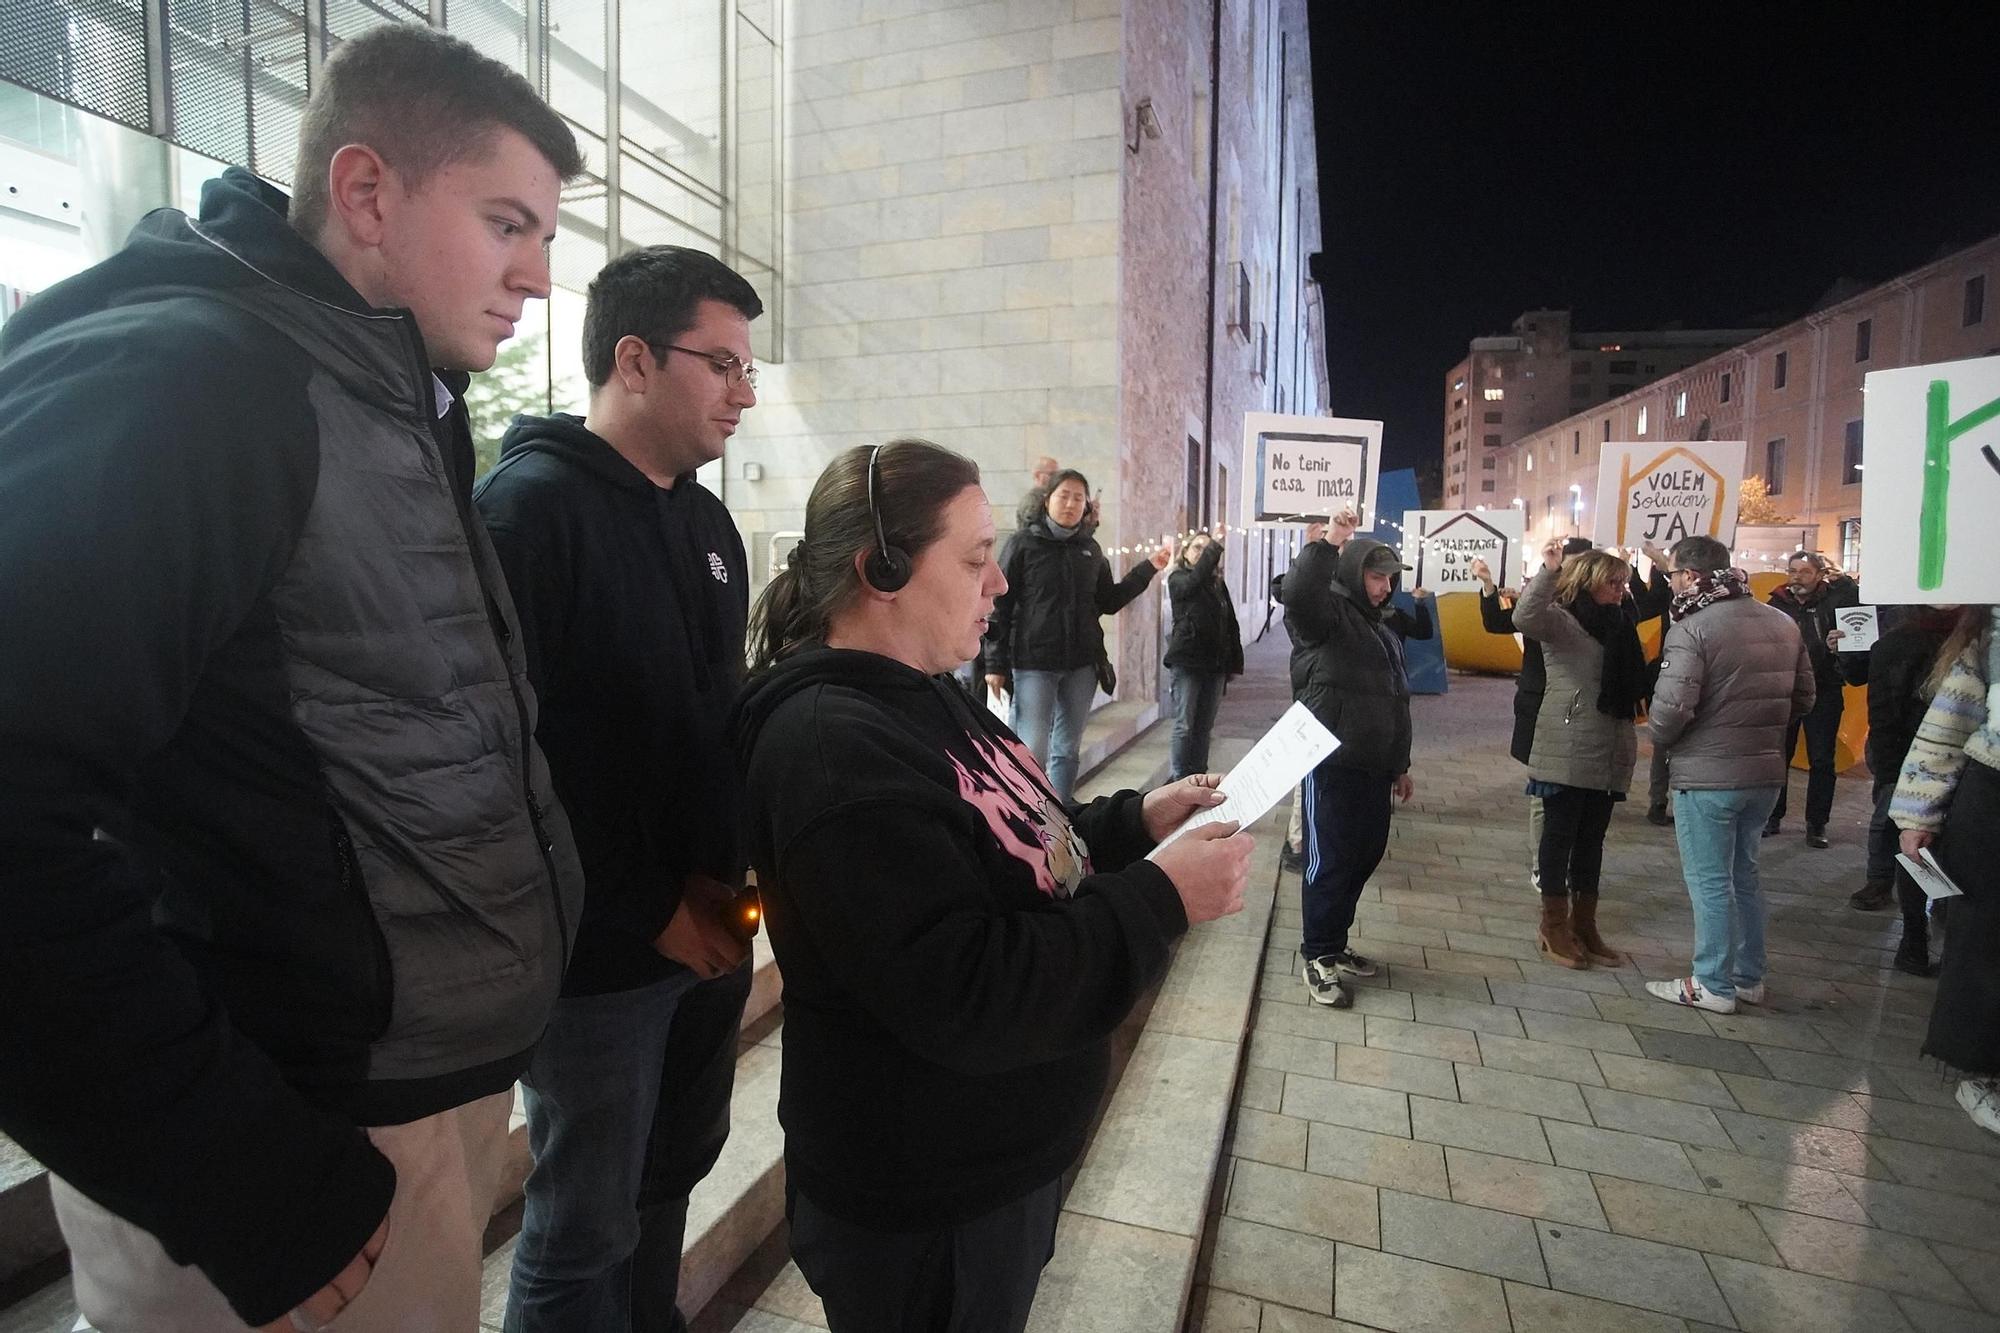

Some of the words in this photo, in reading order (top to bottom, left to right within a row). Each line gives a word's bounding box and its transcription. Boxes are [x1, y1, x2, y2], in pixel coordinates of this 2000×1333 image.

[1272, 453, 1290, 470] No
[1298, 454, 1331, 472] tenir
[1272, 478, 1305, 492] casa
[1317, 478, 1354, 497] mata
[1648, 470, 1705, 491] VOLEM
[1631, 490, 1711, 509] Solucions
